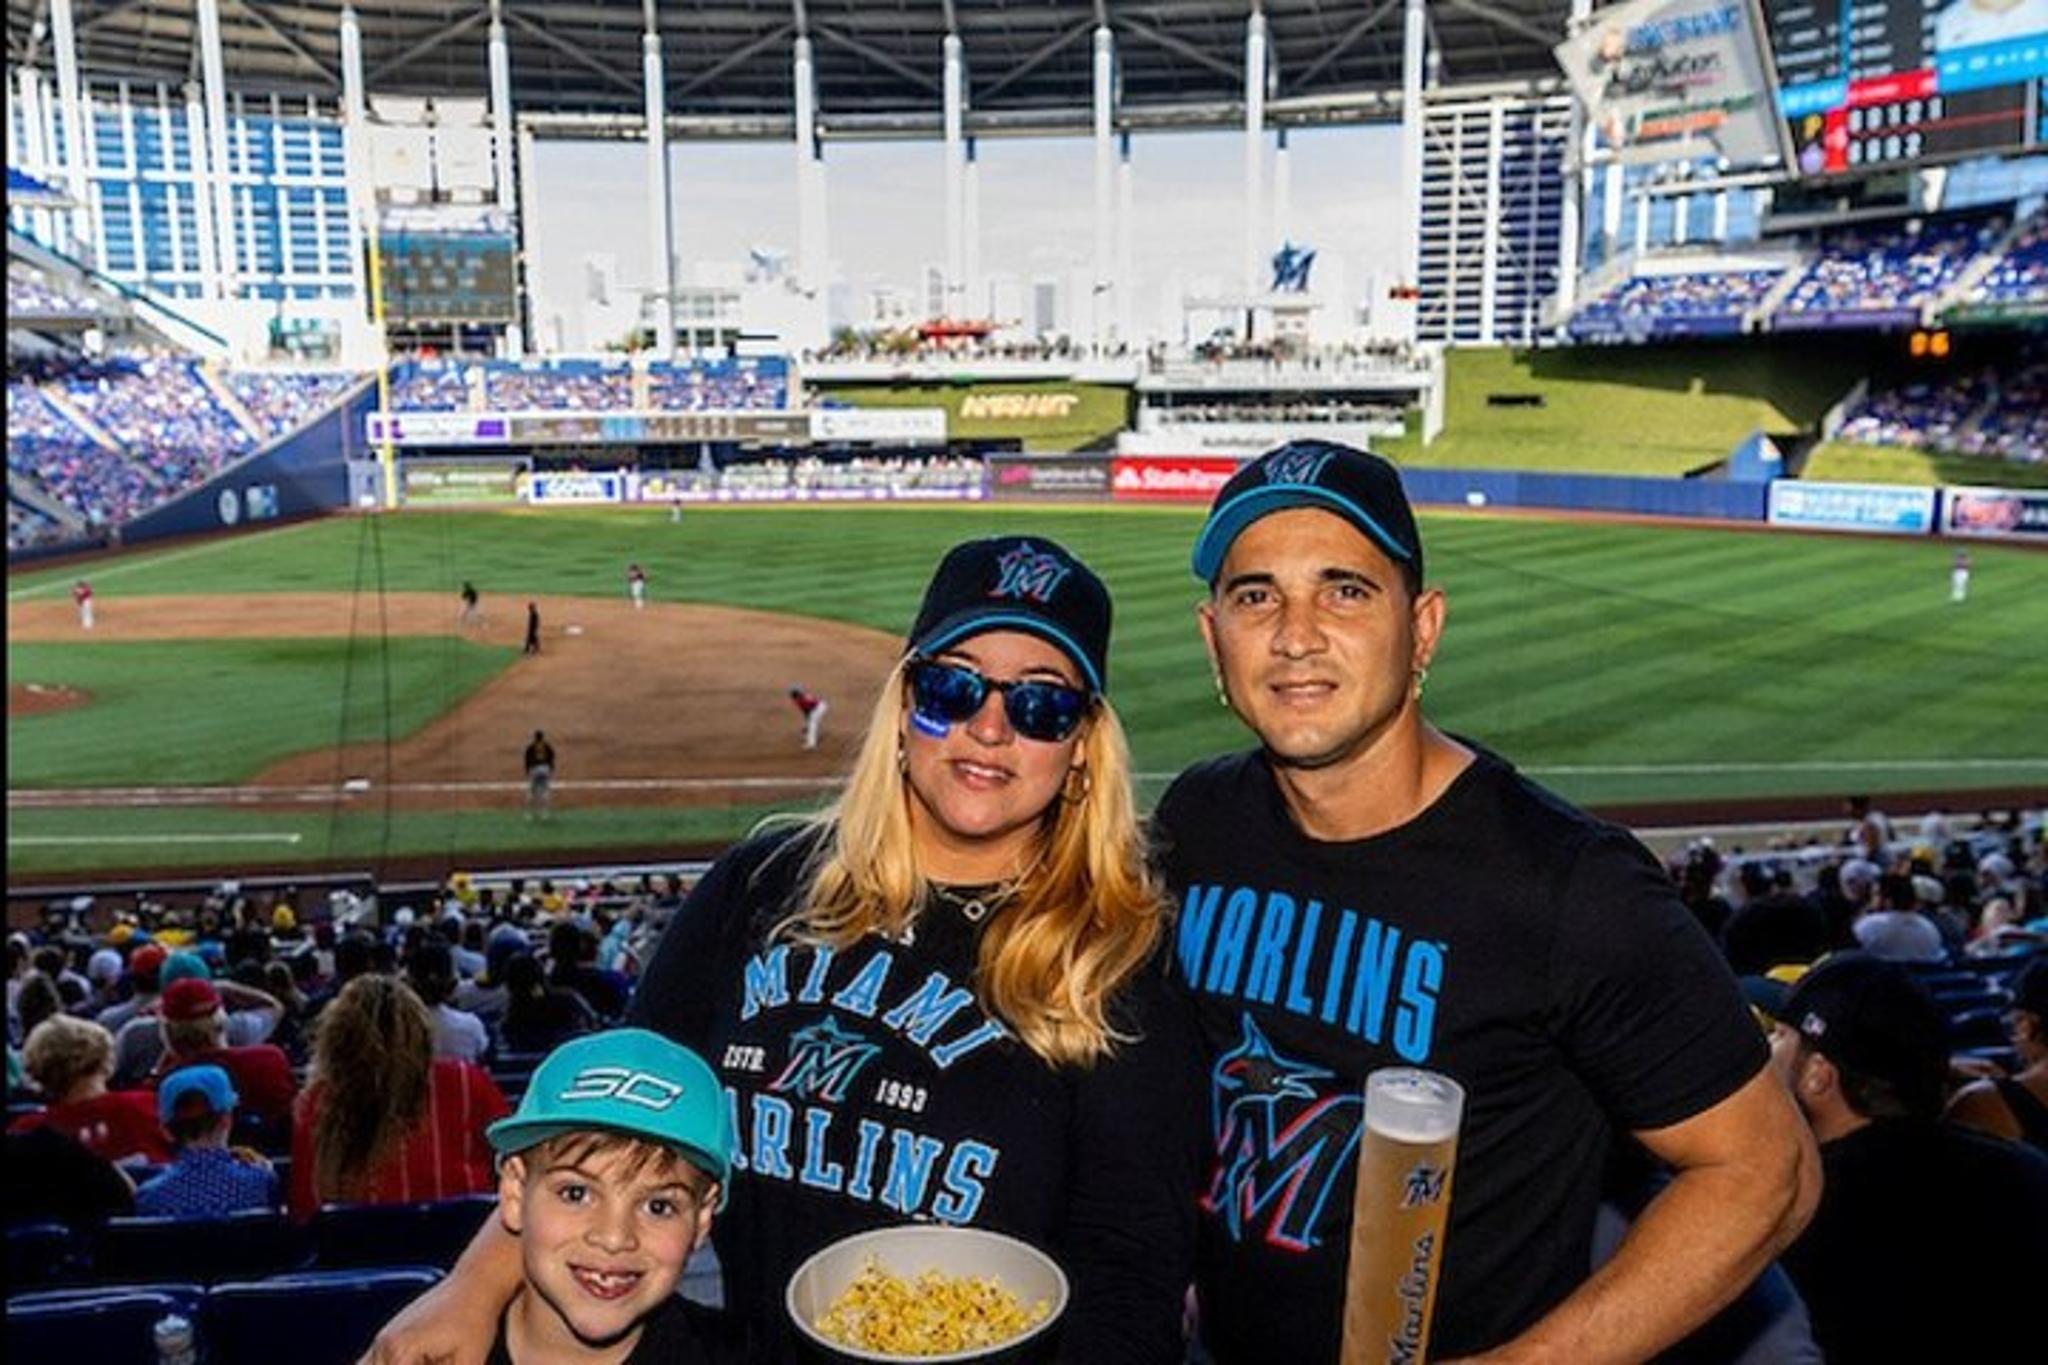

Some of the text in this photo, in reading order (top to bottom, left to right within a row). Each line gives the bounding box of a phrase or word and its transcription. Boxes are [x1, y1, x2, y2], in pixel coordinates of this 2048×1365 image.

[741, 944, 1006, 1069] MIAMI
[1177, 884, 1446, 1063] MARLINS
[725, 1086, 1000, 1225] RLINS
[875, 1079, 928, 1113] 1993
